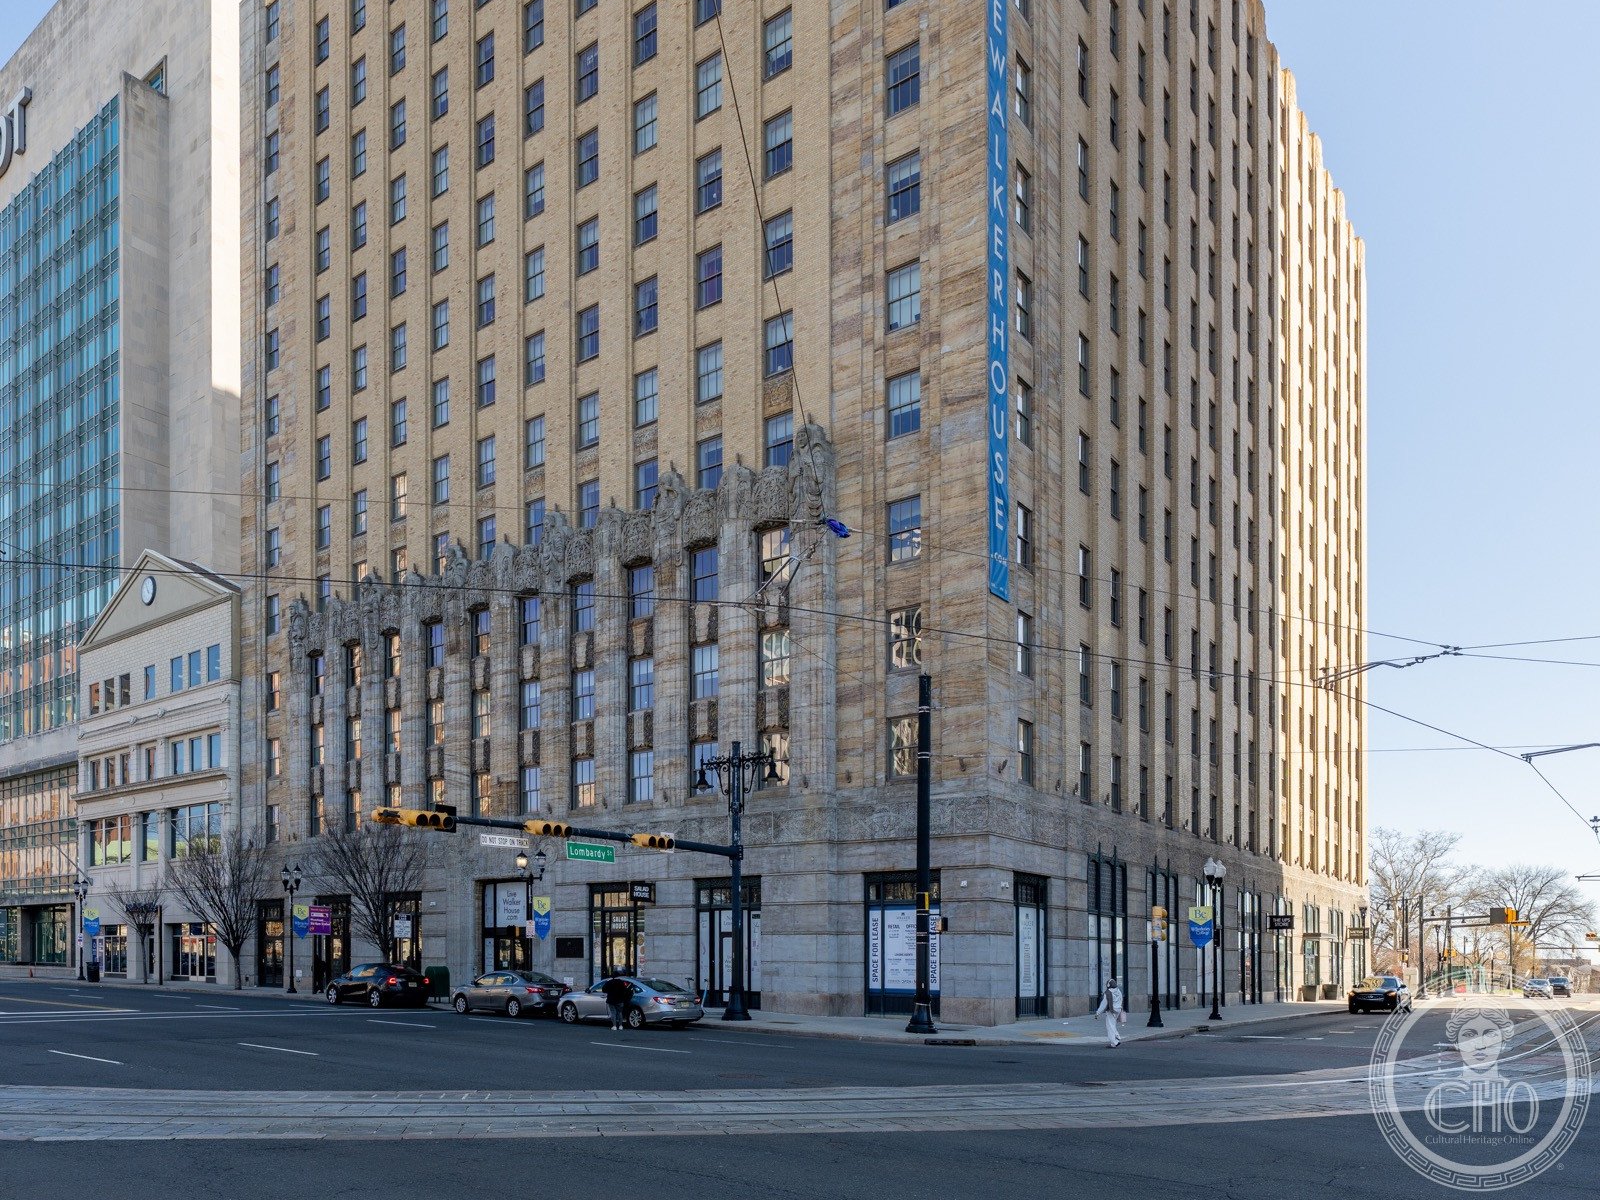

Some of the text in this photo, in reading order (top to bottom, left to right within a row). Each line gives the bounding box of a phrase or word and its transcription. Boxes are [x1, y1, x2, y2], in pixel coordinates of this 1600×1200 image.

[570, 846, 605, 860] Lombardy
[633, 891, 650, 899] HOUSE
[503, 898, 521, 906] Walker
[612, 922, 628, 930] HOUSE
[871, 917, 879, 983] SPACE FOR LEASE
